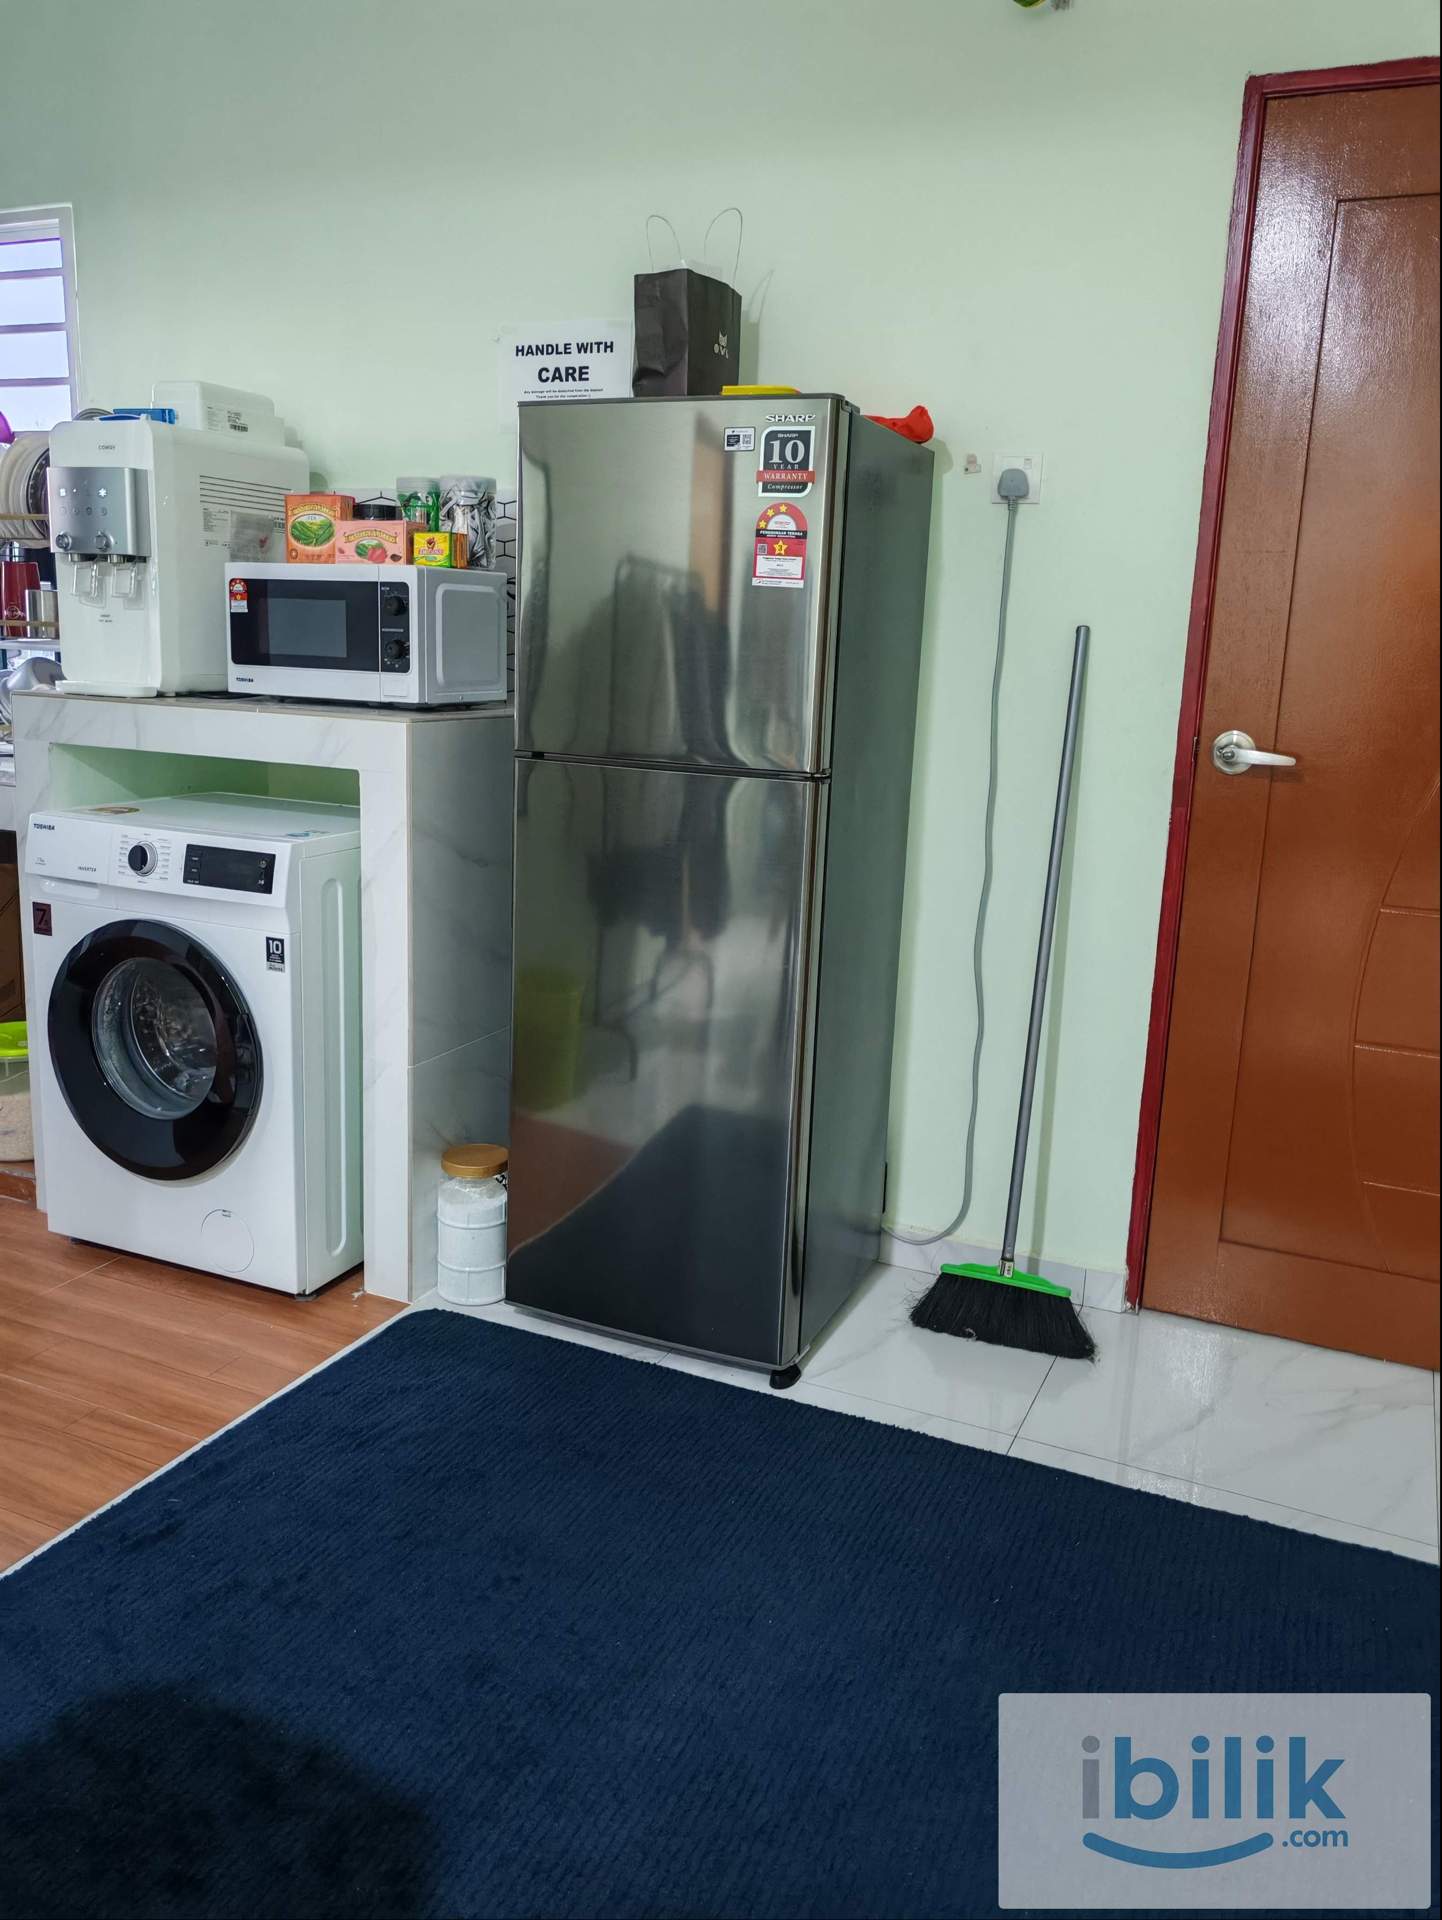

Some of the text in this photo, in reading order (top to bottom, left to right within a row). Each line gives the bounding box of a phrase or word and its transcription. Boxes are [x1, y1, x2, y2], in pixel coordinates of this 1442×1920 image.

[515, 341, 614, 357] HANDLE WITH
[537, 365, 590, 383] CARE
[765, 414, 816, 423] SHARP
[768, 439, 805, 464] 10
[763, 472, 808, 480] WARRANTY
[767, 483, 804, 491] Compressor
[33, 823, 56, 831] TOSHIBA
[268, 940, 282, 954] 10
